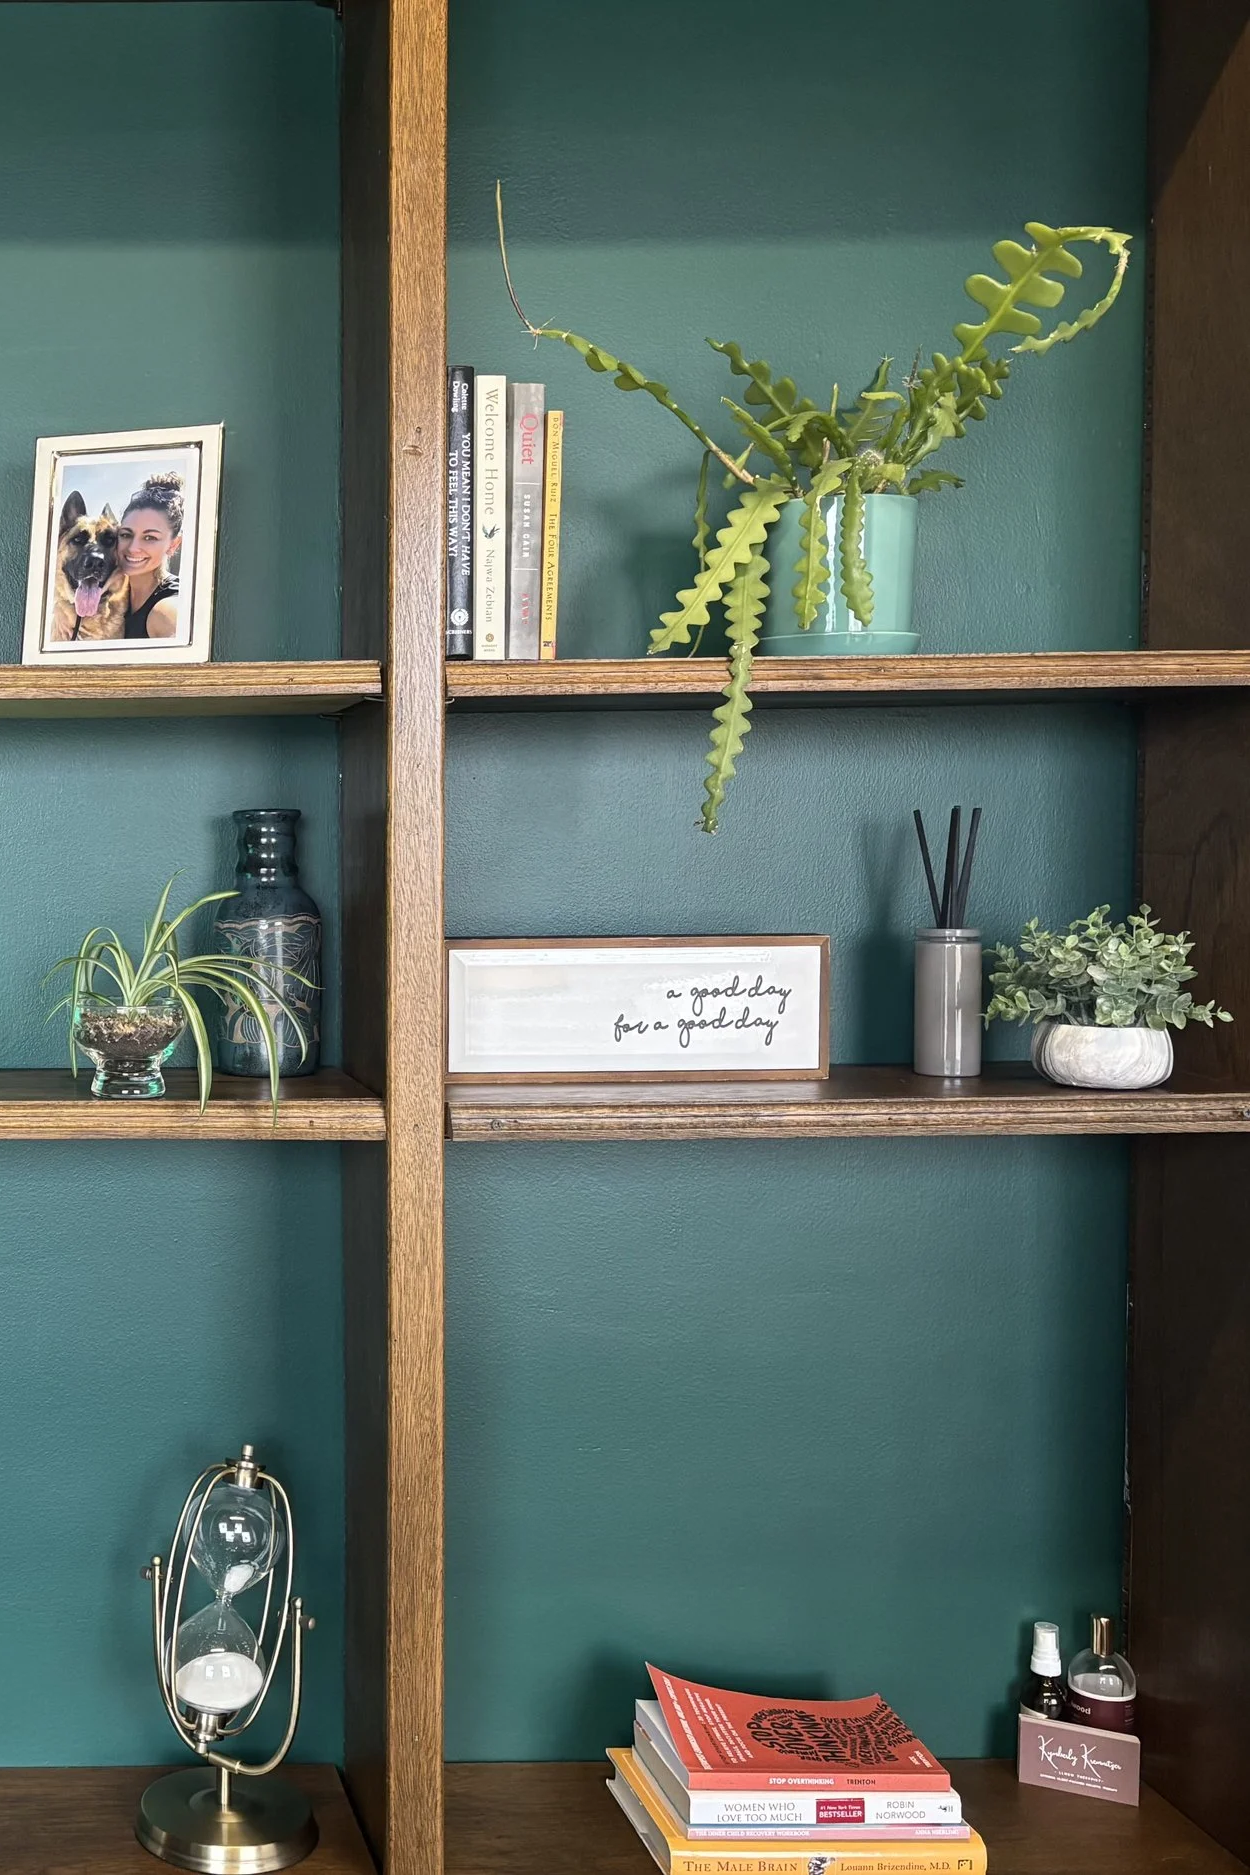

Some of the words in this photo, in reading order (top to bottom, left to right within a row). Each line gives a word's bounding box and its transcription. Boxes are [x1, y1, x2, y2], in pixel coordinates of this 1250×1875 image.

[451, 380, 461, 413] Dowling
[484, 388, 499, 461] Welcome
[519, 413, 539, 465] Quiet
[448, 450, 458, 467] TO
[461, 432, 471, 458] YOU
[551, 441, 560, 478] MIGUEL
[448, 470, 459, 495] FEEL
[461, 460, 471, 494] MEAN
[484, 468, 499, 515] Home
[448, 498, 458, 522] THIS
[461, 504, 471, 542] DON'T
[523, 494, 531, 528] SUSAN
[548, 514, 557, 530] THE
[448, 526, 458, 557] WAY?
[522, 533, 530, 558] CAIN
[547, 534, 557, 558] FOUR
[461, 545, 471, 577] HAVE
[484, 549, 495, 583] Najwa
[485, 586, 496, 623] Zebian
[545, 561, 555, 621] AGREEMENTS
[666, 989, 683, 999] a
[690, 975, 748, 1017] good
[747, 975, 793, 1015] day
[614, 1013, 650, 1043] for
[653, 1021, 669, 1031] a
[677, 1006, 734, 1049] good
[734, 1006, 780, 1047] day
[717, 1814, 742, 1823] LOVE
[745, 1813, 768, 1822] TOO
[770, 1813, 802, 1822] MUCH
[724, 1803, 766, 1812] WOMEN
[768, 1802, 795, 1811] WHO
[819, 1810, 863, 1818] BESTSELLER
[875, 1810, 926, 1820] NORWOOD
[886, 1801, 915, 1809] ROBIN
[683, 1861, 711, 1872] THE
[717, 1861, 753, 1872] MALE
[758, 1861, 798, 1872] BRAIN
[840, 1862, 874, 1872] Louann
